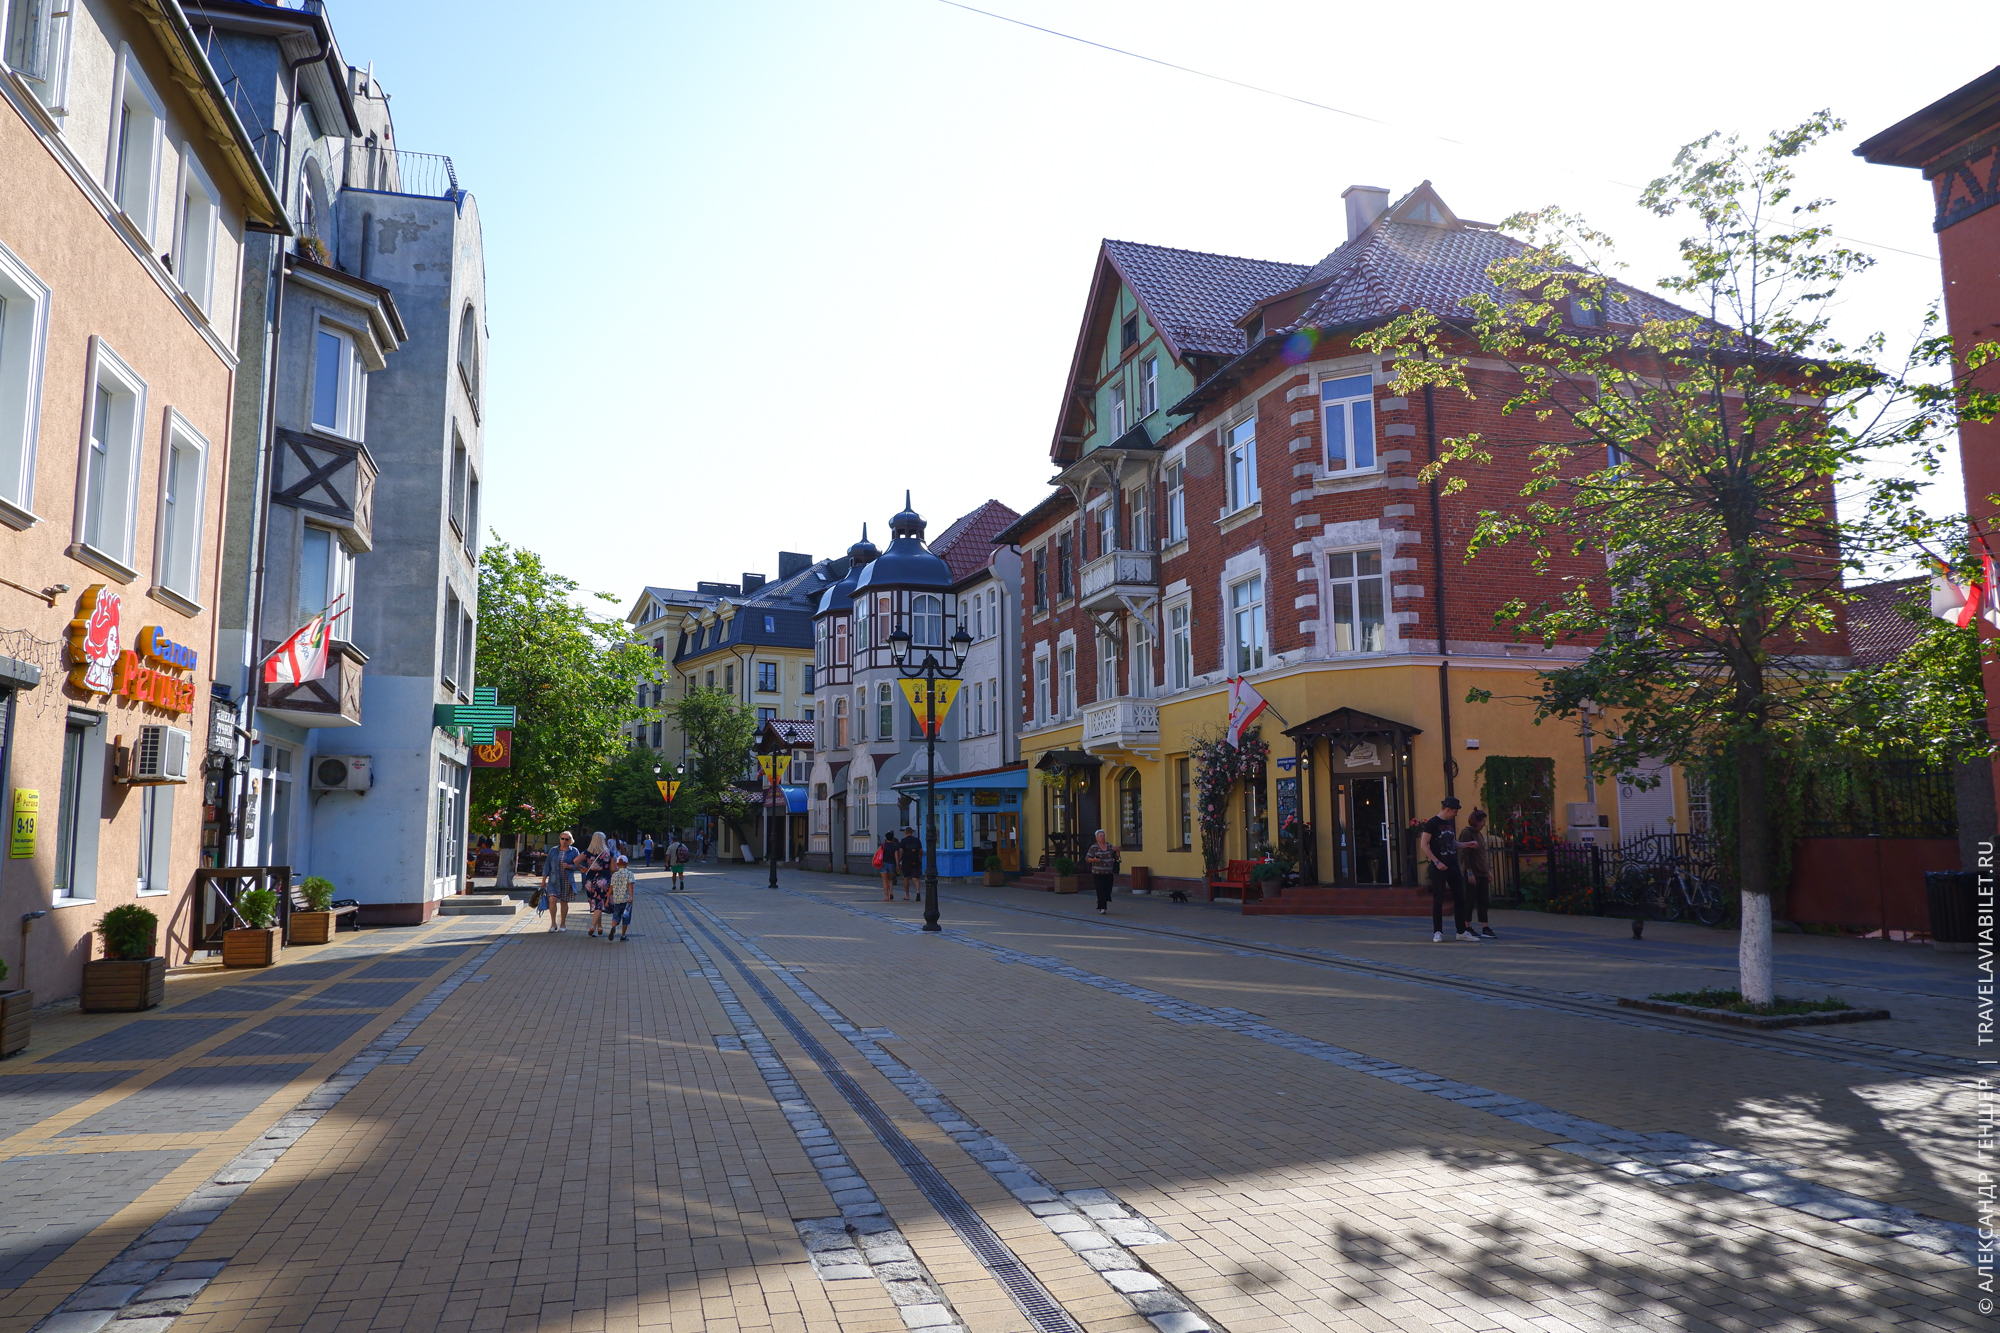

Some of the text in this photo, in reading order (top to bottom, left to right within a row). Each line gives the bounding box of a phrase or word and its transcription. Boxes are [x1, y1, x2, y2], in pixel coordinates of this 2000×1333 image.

[152, 625, 198, 671] Салон
[120, 649, 196, 714] Регина
[17, 817, 35, 834] 9-19
